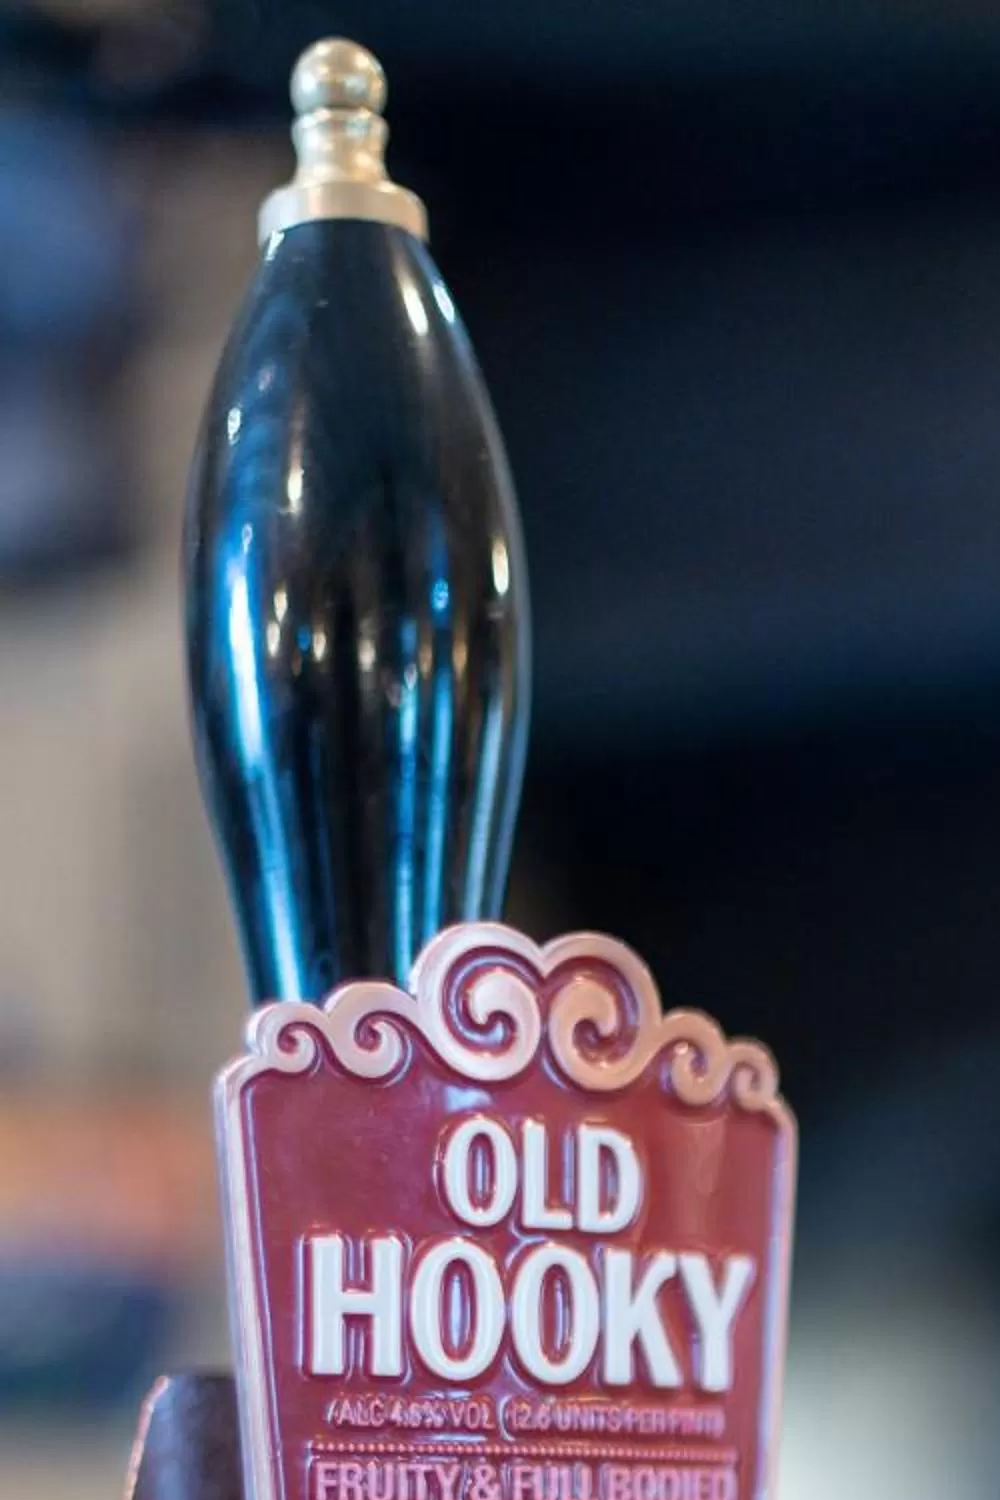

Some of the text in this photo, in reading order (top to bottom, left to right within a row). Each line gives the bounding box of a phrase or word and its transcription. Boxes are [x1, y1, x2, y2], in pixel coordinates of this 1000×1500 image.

[443, 1116, 642, 1234] OLD
[310, 1234, 753, 1393] HOOKY
[450, 1400, 496, 1430] VOL
